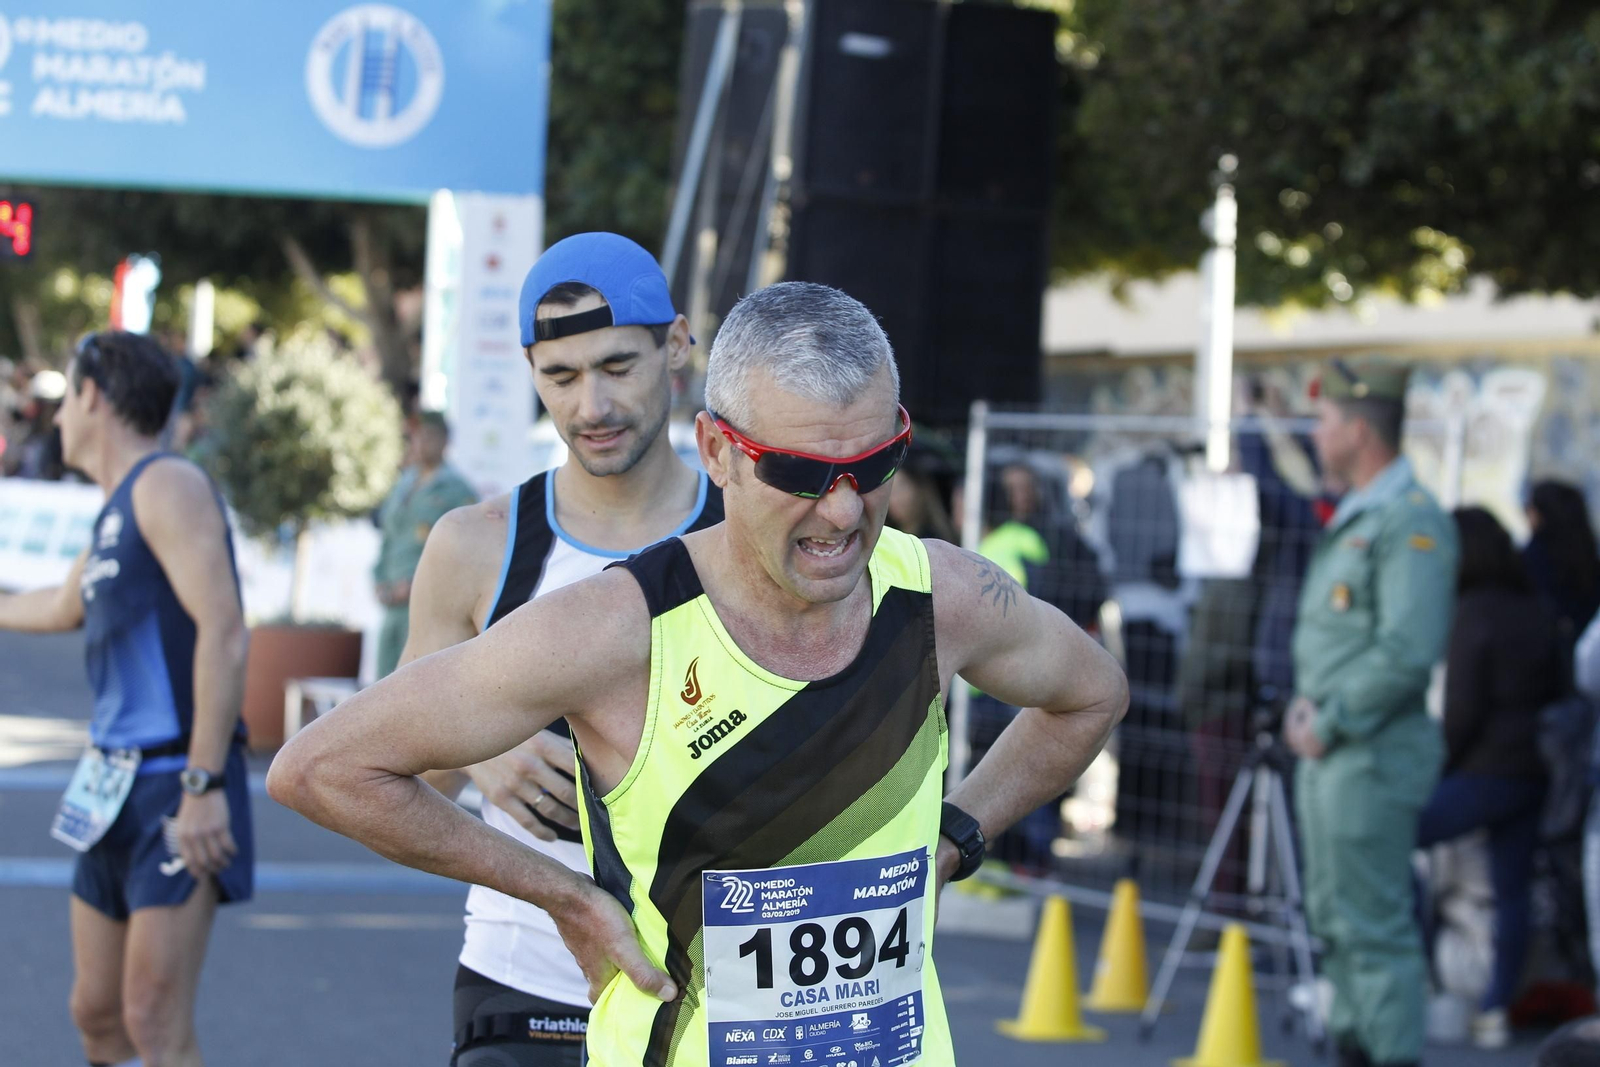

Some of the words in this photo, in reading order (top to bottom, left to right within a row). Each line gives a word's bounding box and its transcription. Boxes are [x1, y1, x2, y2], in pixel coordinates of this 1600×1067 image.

[34, 17, 149, 52] MEDIO
[32, 51, 207, 92] MARATÓN
[879, 859, 919, 879] MEDIO
[760, 878, 796, 889] MEDIO
[853, 876, 917, 899] MARATÓN
[761, 886, 813, 900] MARATÓN
[761, 897, 808, 911] ALMERÍA
[762, 908, 800, 918] 03/02/2019
[738, 906, 910, 989] 1894
[780, 987, 830, 1008] CASA
[835, 979, 880, 1000] MARI
[775, 1010, 793, 1018] JOSE
[795, 1008, 819, 1017] MIGUEL
[821, 1002, 857, 1013] GUERRERO
[858, 997, 884, 1007] PAREDES
[762, 1026, 787, 1039] CDX
[809, 1020, 841, 1032] ALMERÍA
[725, 1030, 755, 1042] NEXA
[726, 1056, 758, 1065] Blanes
